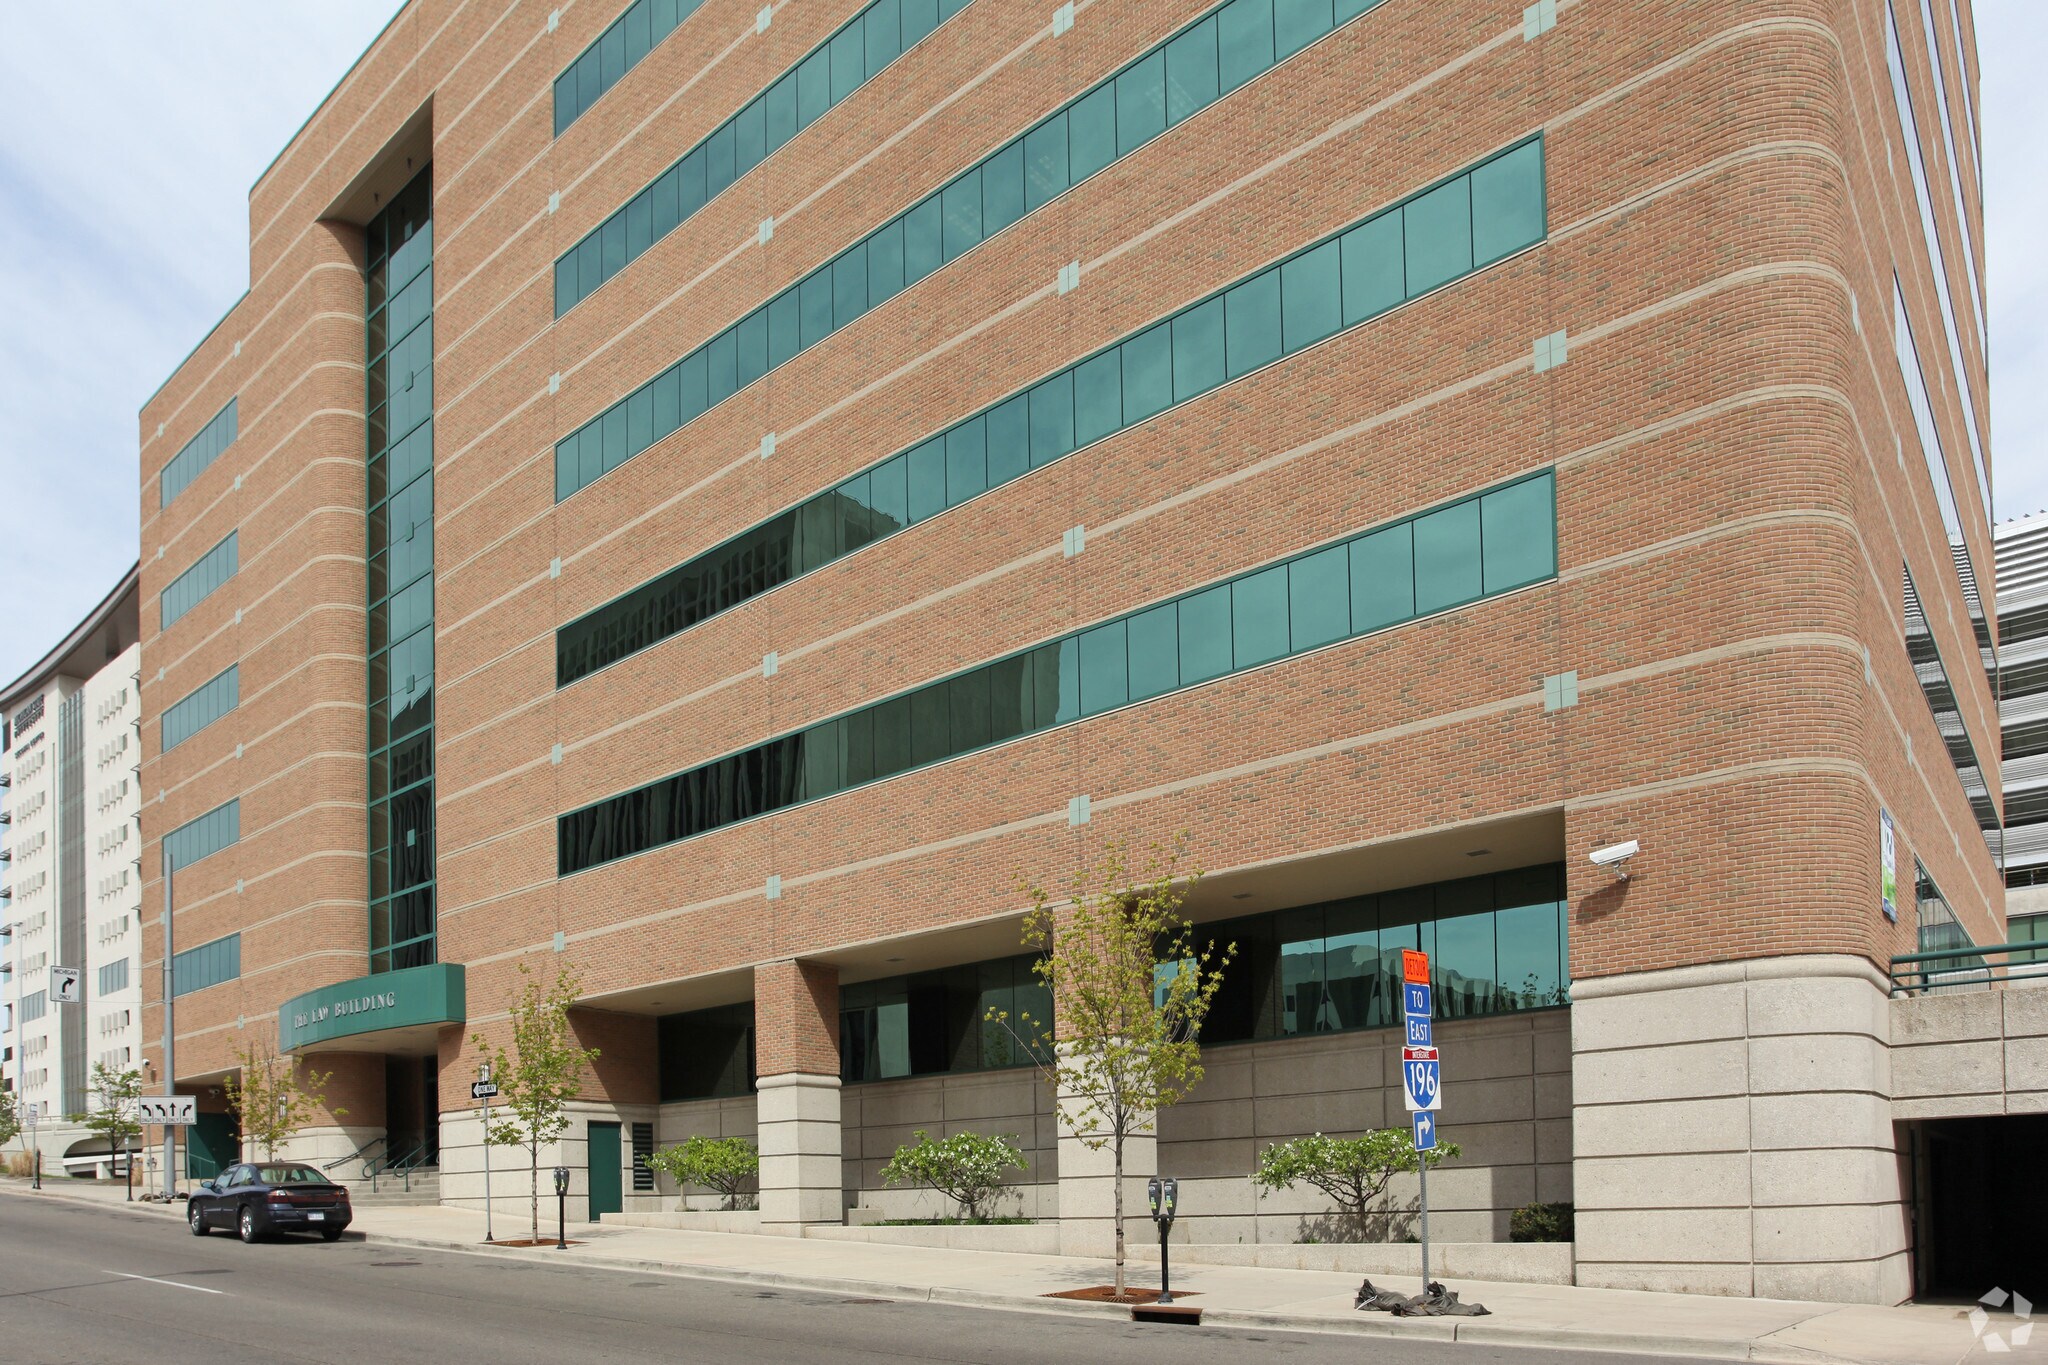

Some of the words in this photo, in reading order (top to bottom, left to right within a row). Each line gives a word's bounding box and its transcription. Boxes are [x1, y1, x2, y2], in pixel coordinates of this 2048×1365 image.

[1405, 957, 1426, 977] DETOUR
[1411, 990, 1423, 1008] TO
[294, 1012, 308, 1029] THE
[312, 1005, 329, 1023] LAW
[334, 992, 395, 1017] BUILDING
[1410, 1020, 1428, 1041] EAST
[1410, 1062, 1436, 1096] 196
